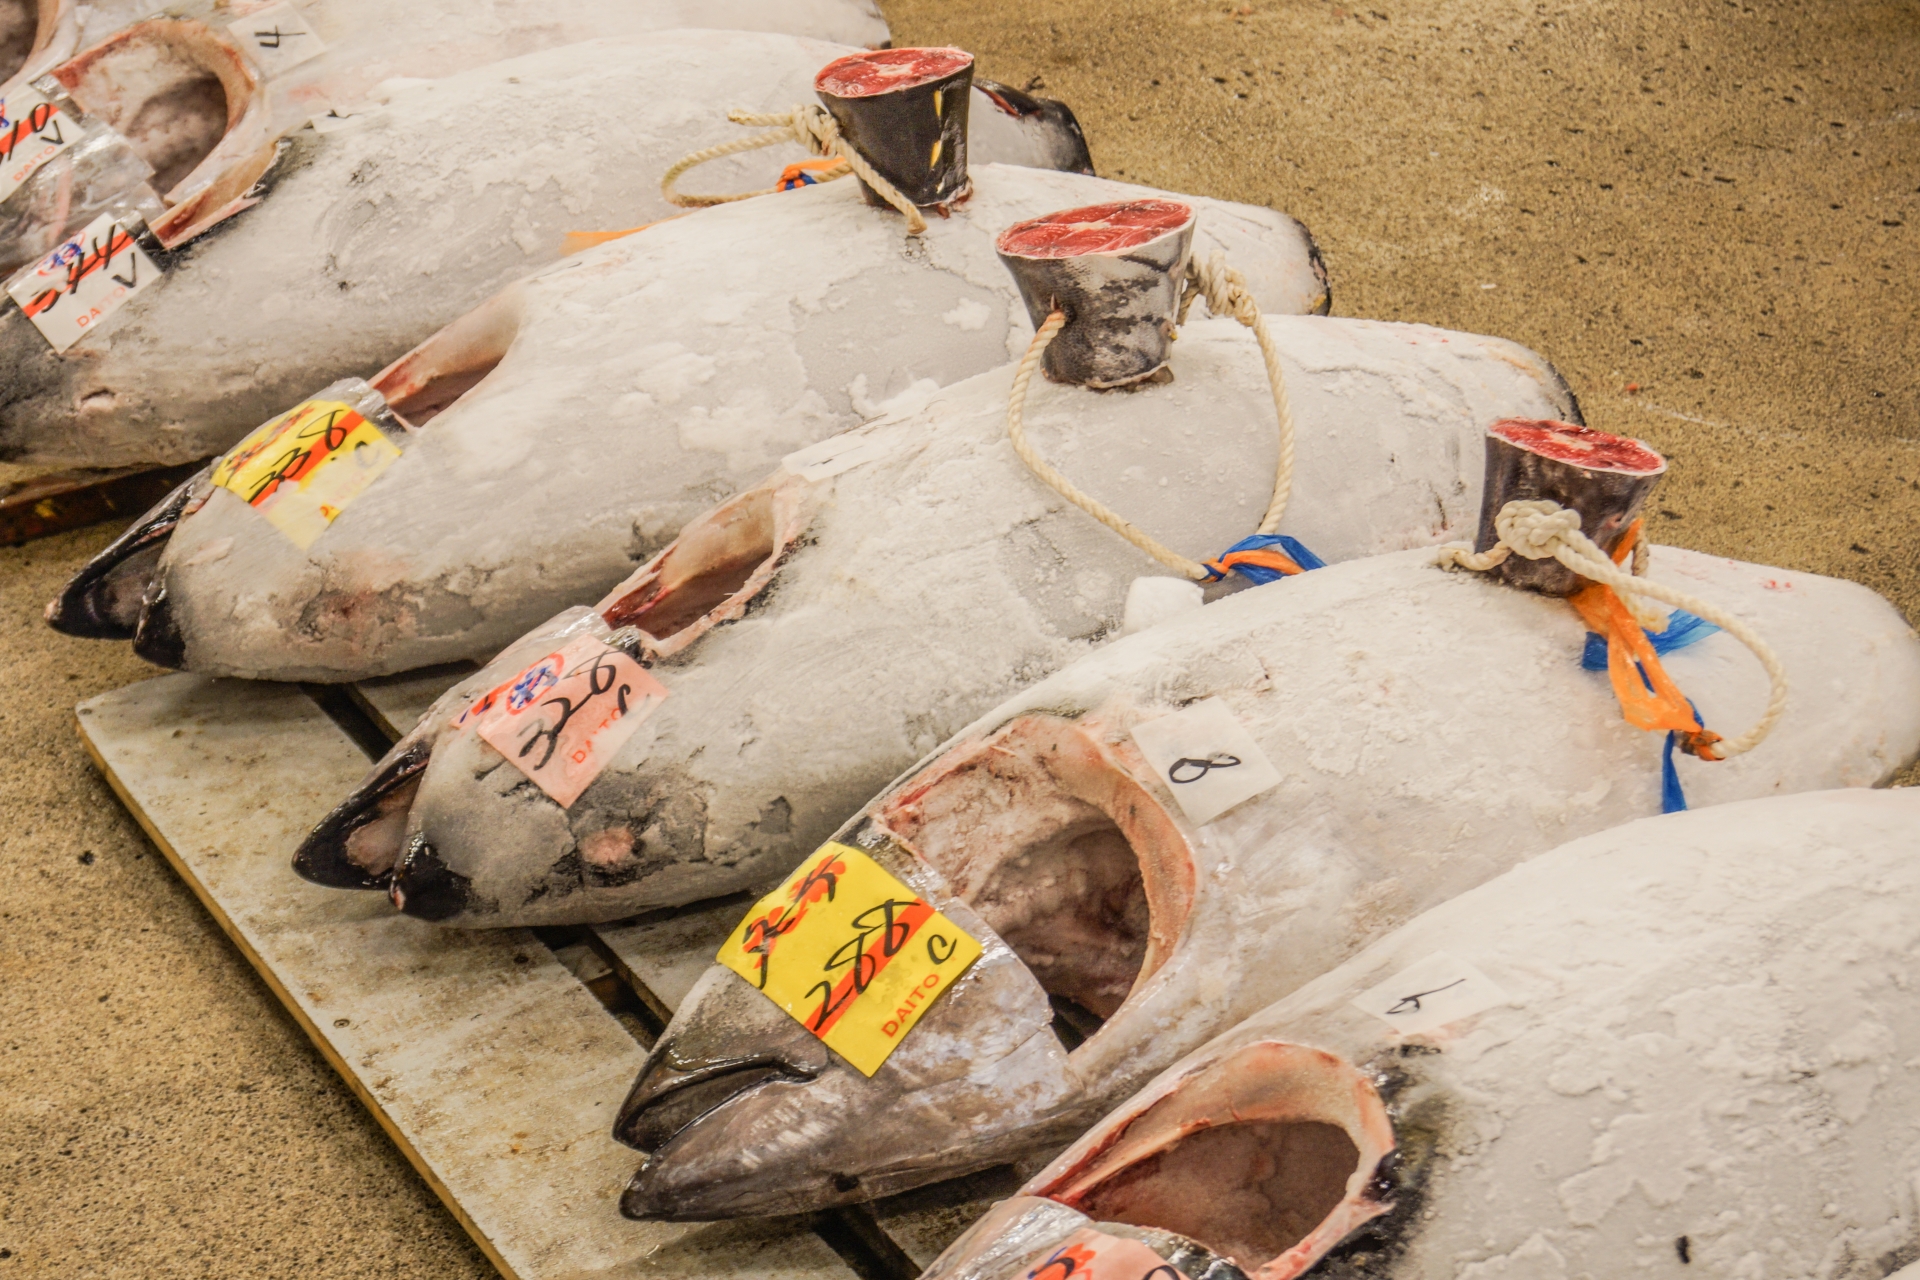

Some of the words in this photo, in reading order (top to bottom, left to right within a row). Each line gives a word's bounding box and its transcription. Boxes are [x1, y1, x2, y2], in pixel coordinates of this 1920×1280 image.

[254, 25, 306, 48] 4
[0, 103, 50, 164] 10
[13, 145, 56, 182] DAITO
[572, 707, 625, 764] DATO
[1169, 752, 1241, 784] 8
[804, 898, 921, 1032] 288
[881, 973, 940, 1038] DAITO
